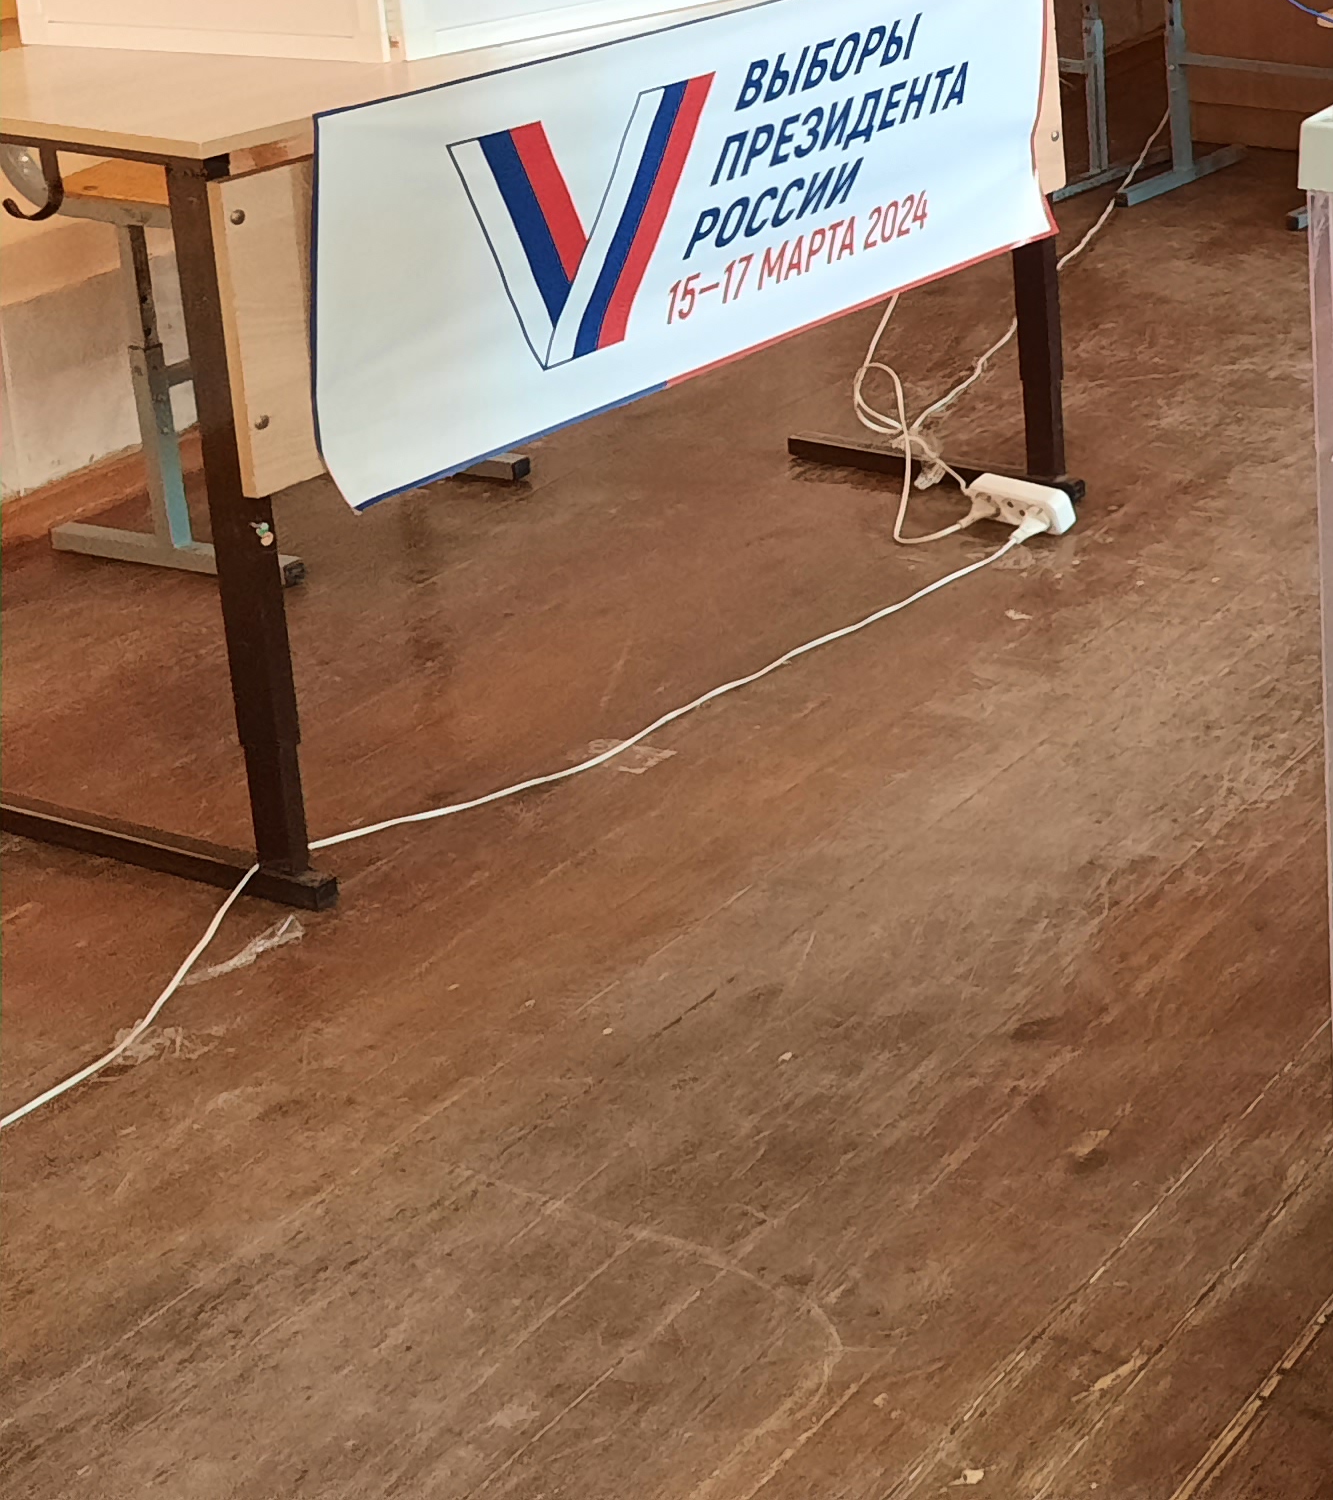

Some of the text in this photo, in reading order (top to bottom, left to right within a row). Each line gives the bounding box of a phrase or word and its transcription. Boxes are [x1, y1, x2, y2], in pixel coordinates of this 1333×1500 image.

[735, 13, 922, 112] ВЫБОРЫ
[711, 61, 969, 186] ПРЕЗИДЕНТА
[683, 158, 864, 259] РОССИИ
[758, 222, 854, 291] МАРТА
[864, 190, 928, 249] 2024
